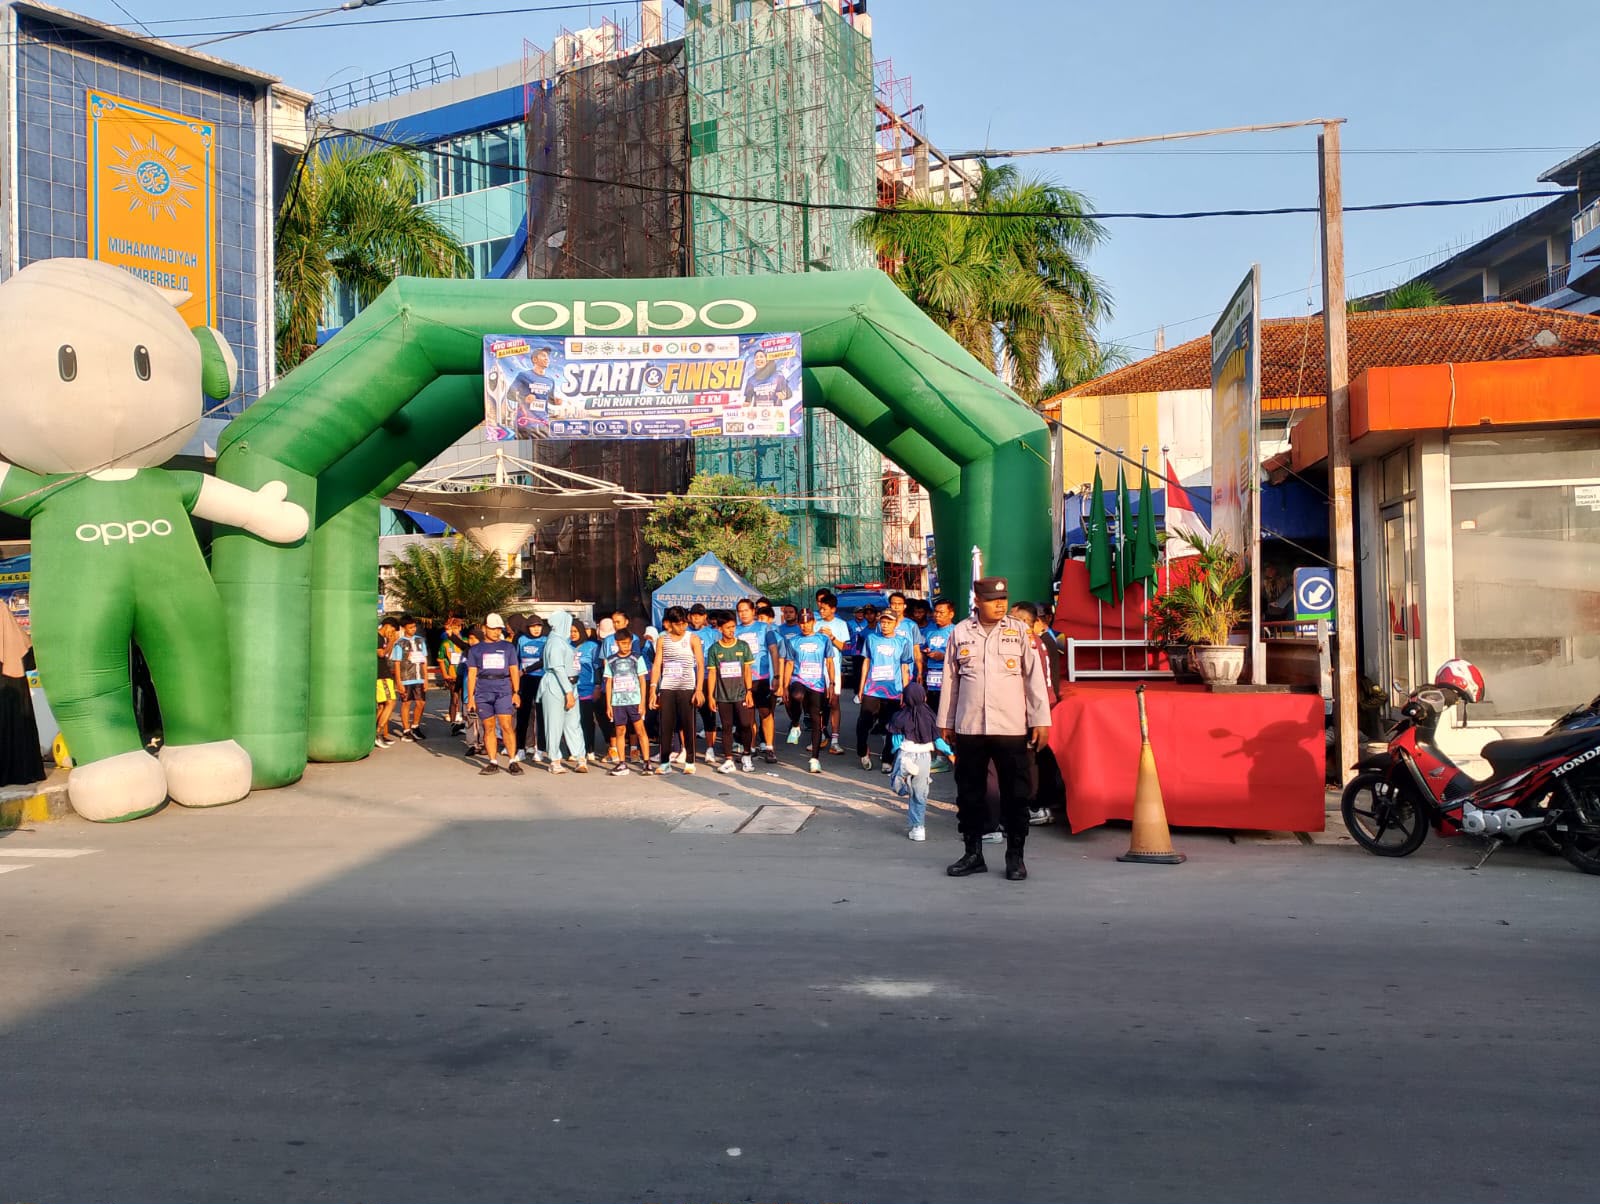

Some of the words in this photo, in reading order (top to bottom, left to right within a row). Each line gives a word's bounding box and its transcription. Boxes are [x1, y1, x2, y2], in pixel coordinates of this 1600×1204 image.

[108, 236, 198, 268] MUHAMMADIYAH
[119, 264, 190, 292] MBERREJO
[511, 299, 757, 335] oppo
[562, 361, 648, 394] START
[648, 370, 659, 383] &
[663, 360, 746, 392] FINISH
[592, 397, 611, 408] FUN
[613, 396, 632, 407] RUN
[635, 396, 653, 406] FOR
[656, 395, 689, 405] TAQWA
[700, 395, 706, 404] 5
[708, 395, 722, 404] KM
[75, 519, 172, 545] oppo
[668, 601, 733, 609] SUMBREJO
[711, 594, 747, 602] TAQWA
